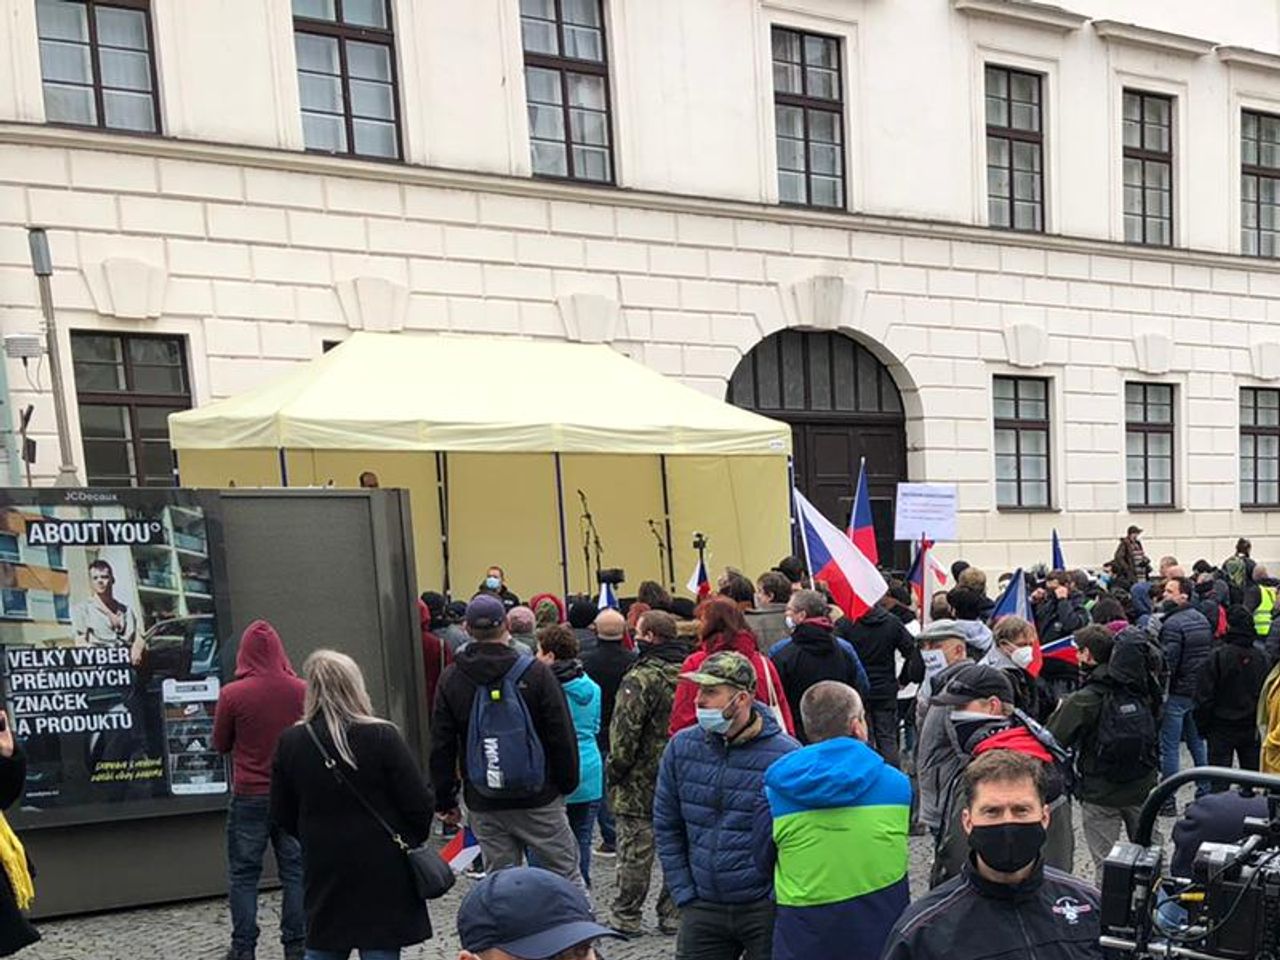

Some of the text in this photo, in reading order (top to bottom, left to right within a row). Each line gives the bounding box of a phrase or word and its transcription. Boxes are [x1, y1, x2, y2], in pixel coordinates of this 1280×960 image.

[64, 491, 118, 501] JCDecaux
[29, 523, 101, 544] ABOUT
[11, 666, 131, 691] PRÉMIOVÝCH
[13, 691, 89, 713] ZNAČEK
[18, 718, 31, 736] A
[484, 738, 500, 770] PUMA
